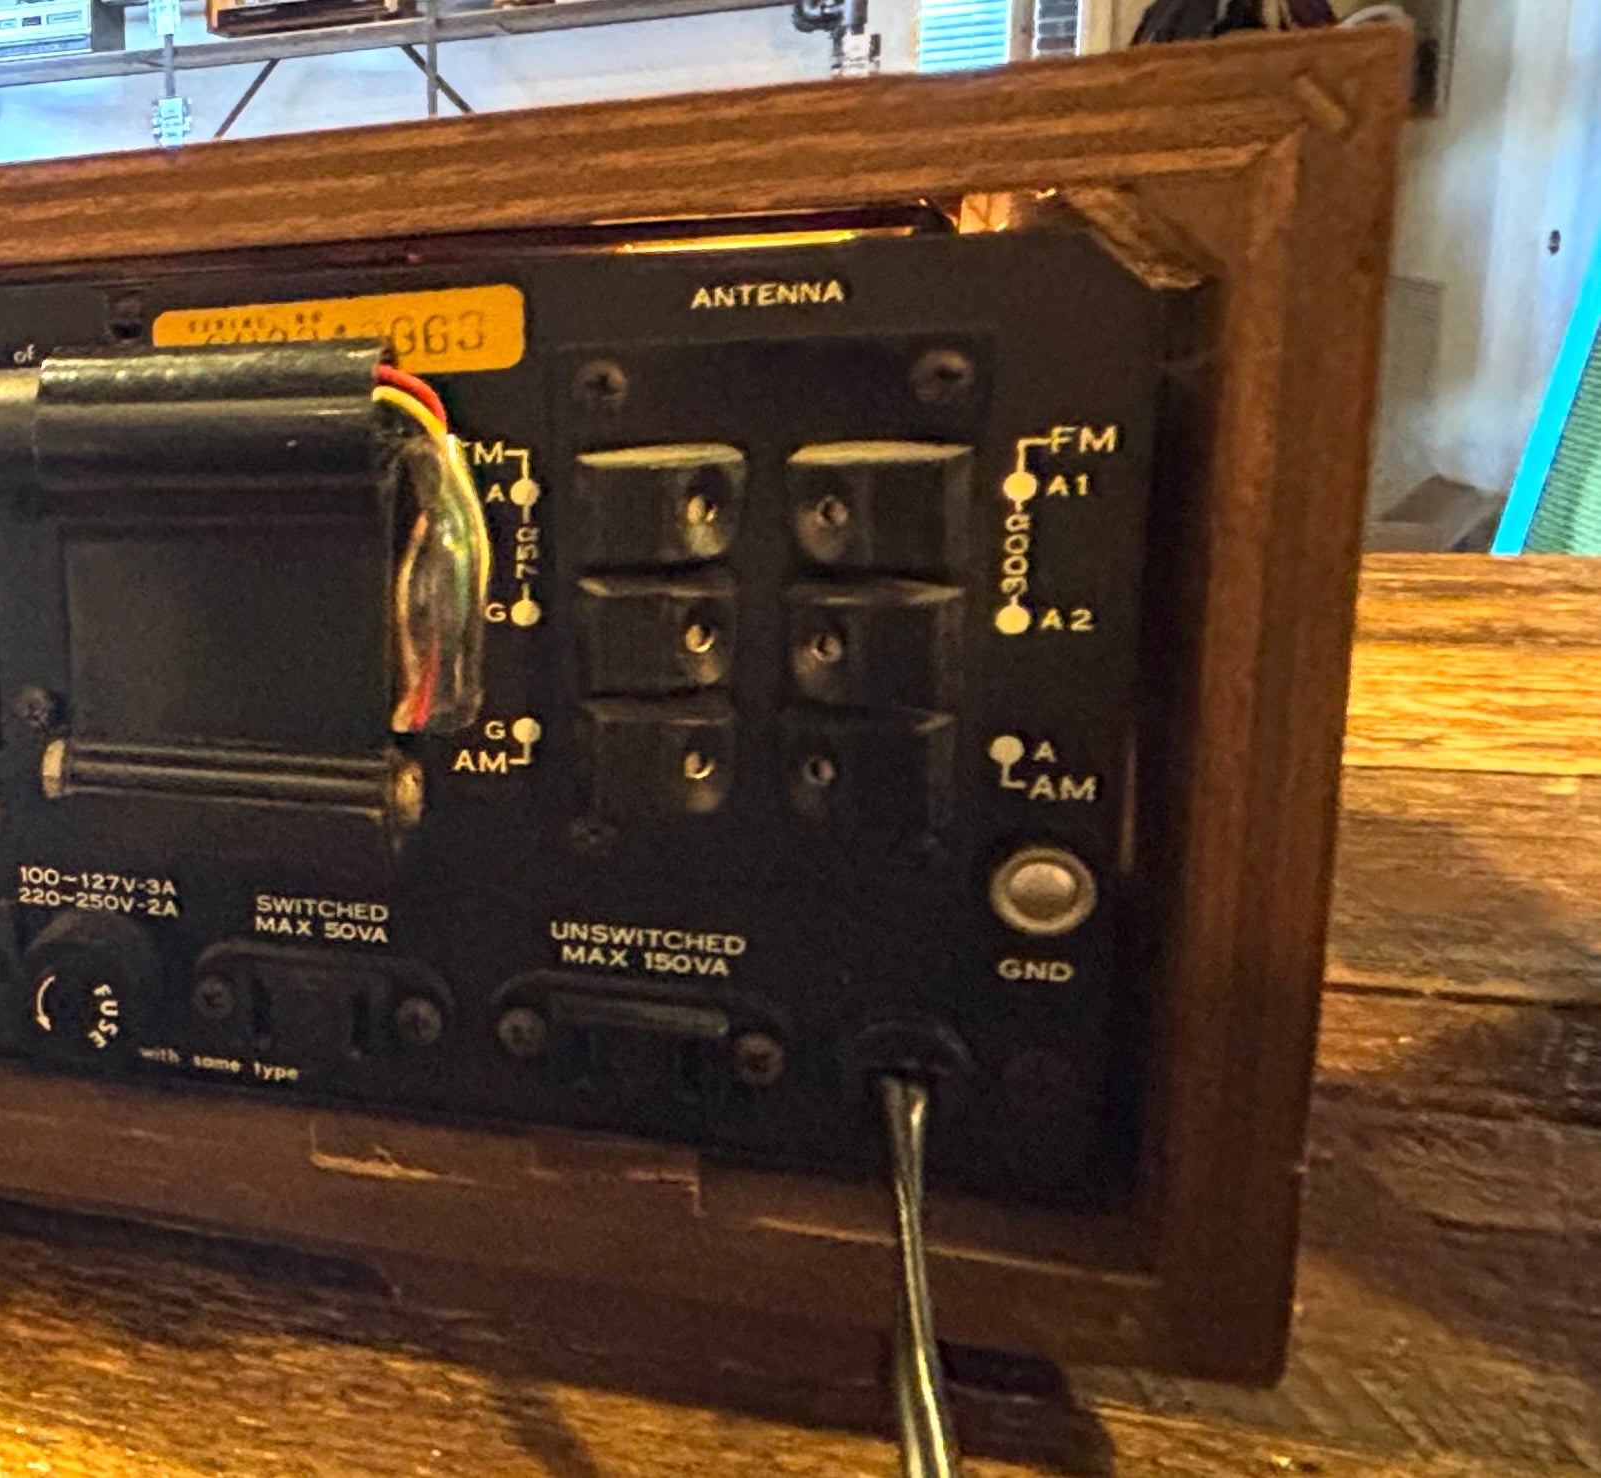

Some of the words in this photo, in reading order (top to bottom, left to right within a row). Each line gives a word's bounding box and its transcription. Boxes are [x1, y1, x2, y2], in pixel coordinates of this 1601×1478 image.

[690, 280, 844, 310] ANTENNA
[13, 344, 35, 363] of
[1050, 425, 1118, 453] FM
[486, 483, 505, 503] A
[1047, 474, 1089, 496] A1
[484, 602, 507, 622] G
[1041, 608, 1093, 631] A2
[484, 722, 507, 741] G
[453, 750, 507, 774] AM
[1031, 741, 1057, 763] A
[1028, 774, 1097, 803] AM
[255, 894, 389, 923] SWITCHED
[254, 915, 313, 937] MAX
[324, 921, 389, 944] 50VA
[550, 920, 748, 957] UNSWITCHED
[561, 944, 629, 968] MAX
[643, 951, 731, 977] 150VA
[998, 958, 1074, 983] GND
[87, 983, 120, 1049] FUSE
[193, 1055, 241, 1074] same
[253, 1060, 299, 1083] type
